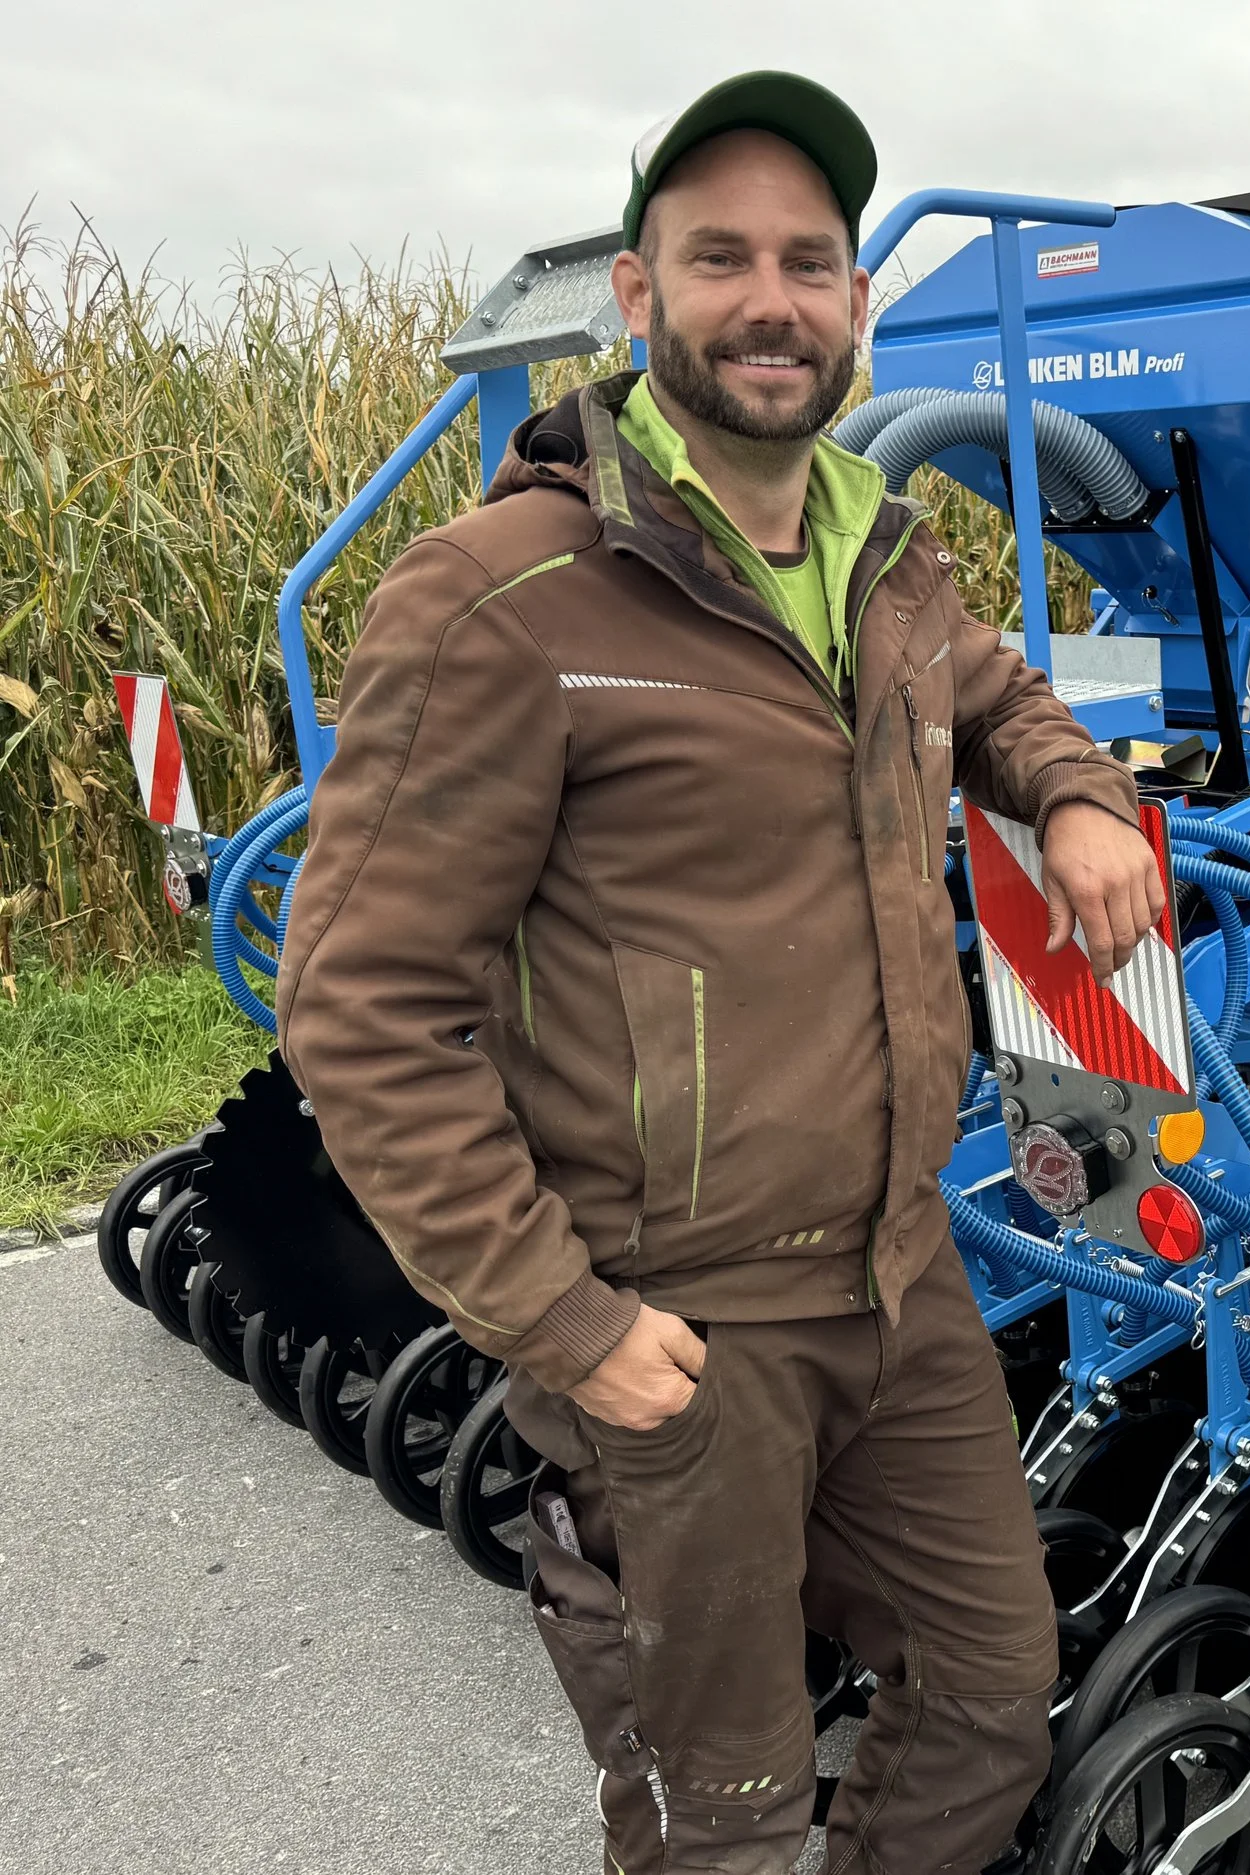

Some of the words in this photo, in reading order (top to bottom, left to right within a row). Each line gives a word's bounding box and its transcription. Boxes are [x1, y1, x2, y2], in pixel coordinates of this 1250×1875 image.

[1051, 250, 1097, 264] BACHMANN
[1089, 348, 1140, 379] BLM
[1144, 352, 1185, 374] Profi
